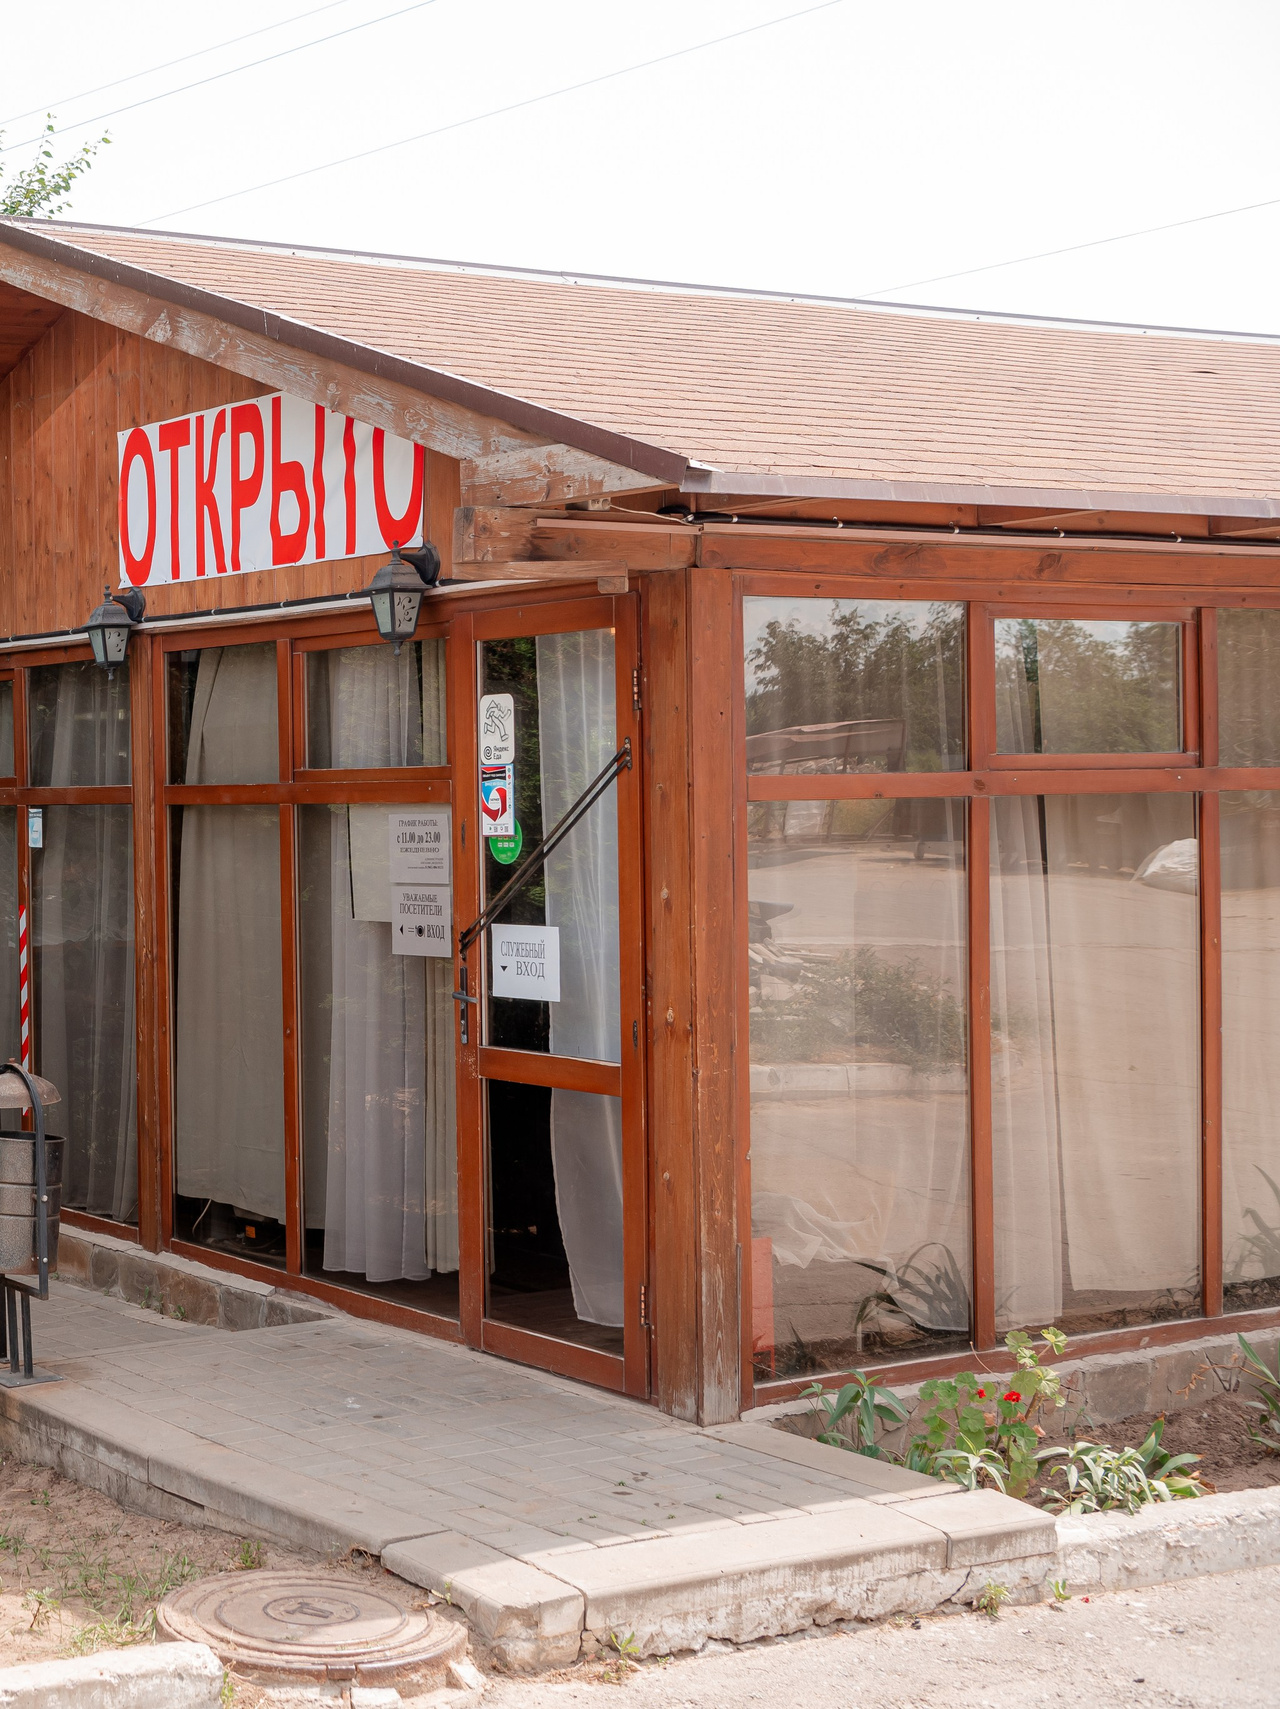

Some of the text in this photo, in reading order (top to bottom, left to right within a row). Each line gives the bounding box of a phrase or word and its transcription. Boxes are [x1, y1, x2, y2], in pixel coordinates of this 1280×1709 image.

[398, 819, 417, 827] ГРАФИК
[401, 831, 416, 844] 11.00
[417, 834, 424, 845] до
[425, 831, 441, 844] 23.00
[400, 846, 440, 854] ЕЖЕДНЕВНО
[402, 893, 438, 903] УВАЖАЕМЫЕ
[399, 903, 443, 916] ПОСЕТИТЕЛИ
[426, 924, 445, 942] ВХОД
[500, 939, 546, 959] СЛУЖЕБНЫЙ
[516, 961, 546, 981] ВХОД
